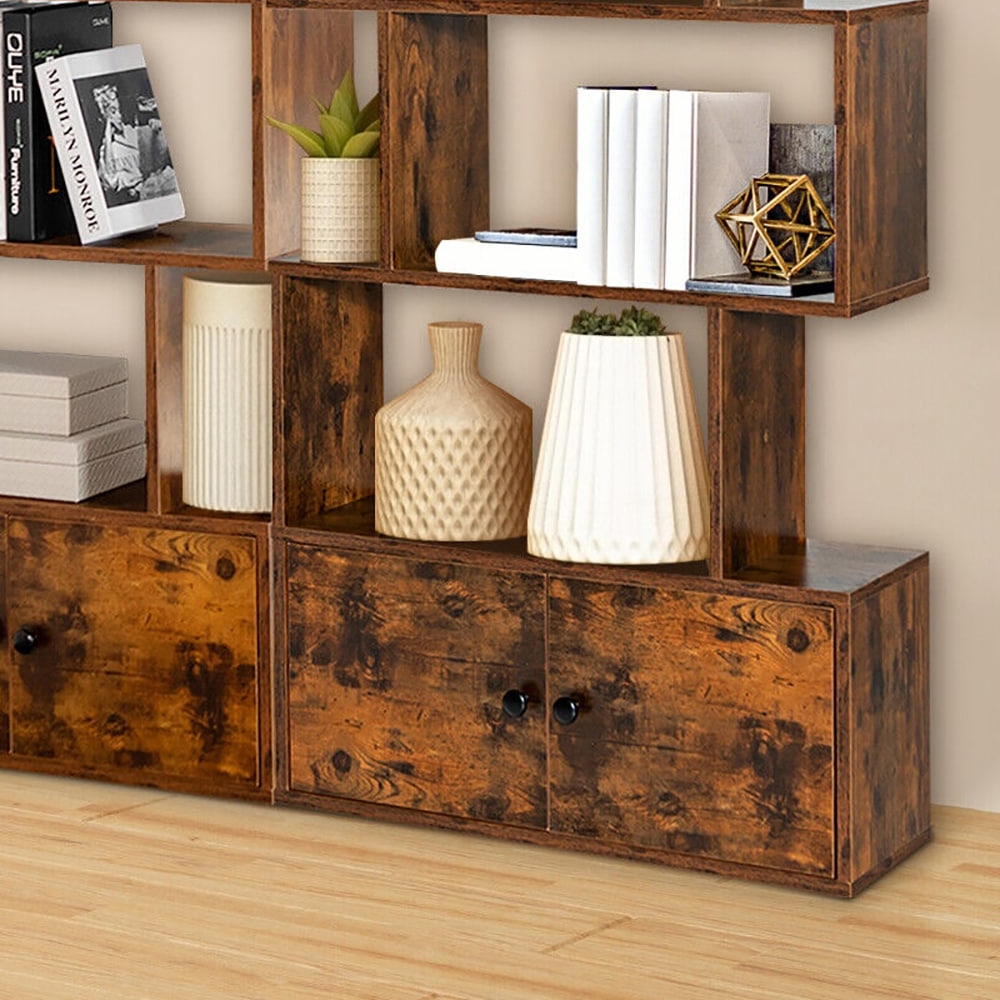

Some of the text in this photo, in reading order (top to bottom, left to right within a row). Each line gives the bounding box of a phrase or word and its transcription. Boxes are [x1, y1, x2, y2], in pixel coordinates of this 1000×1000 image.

[10, 146, 21, 215] Furniture
[46, 68, 101, 234] MARILYN MONROE
